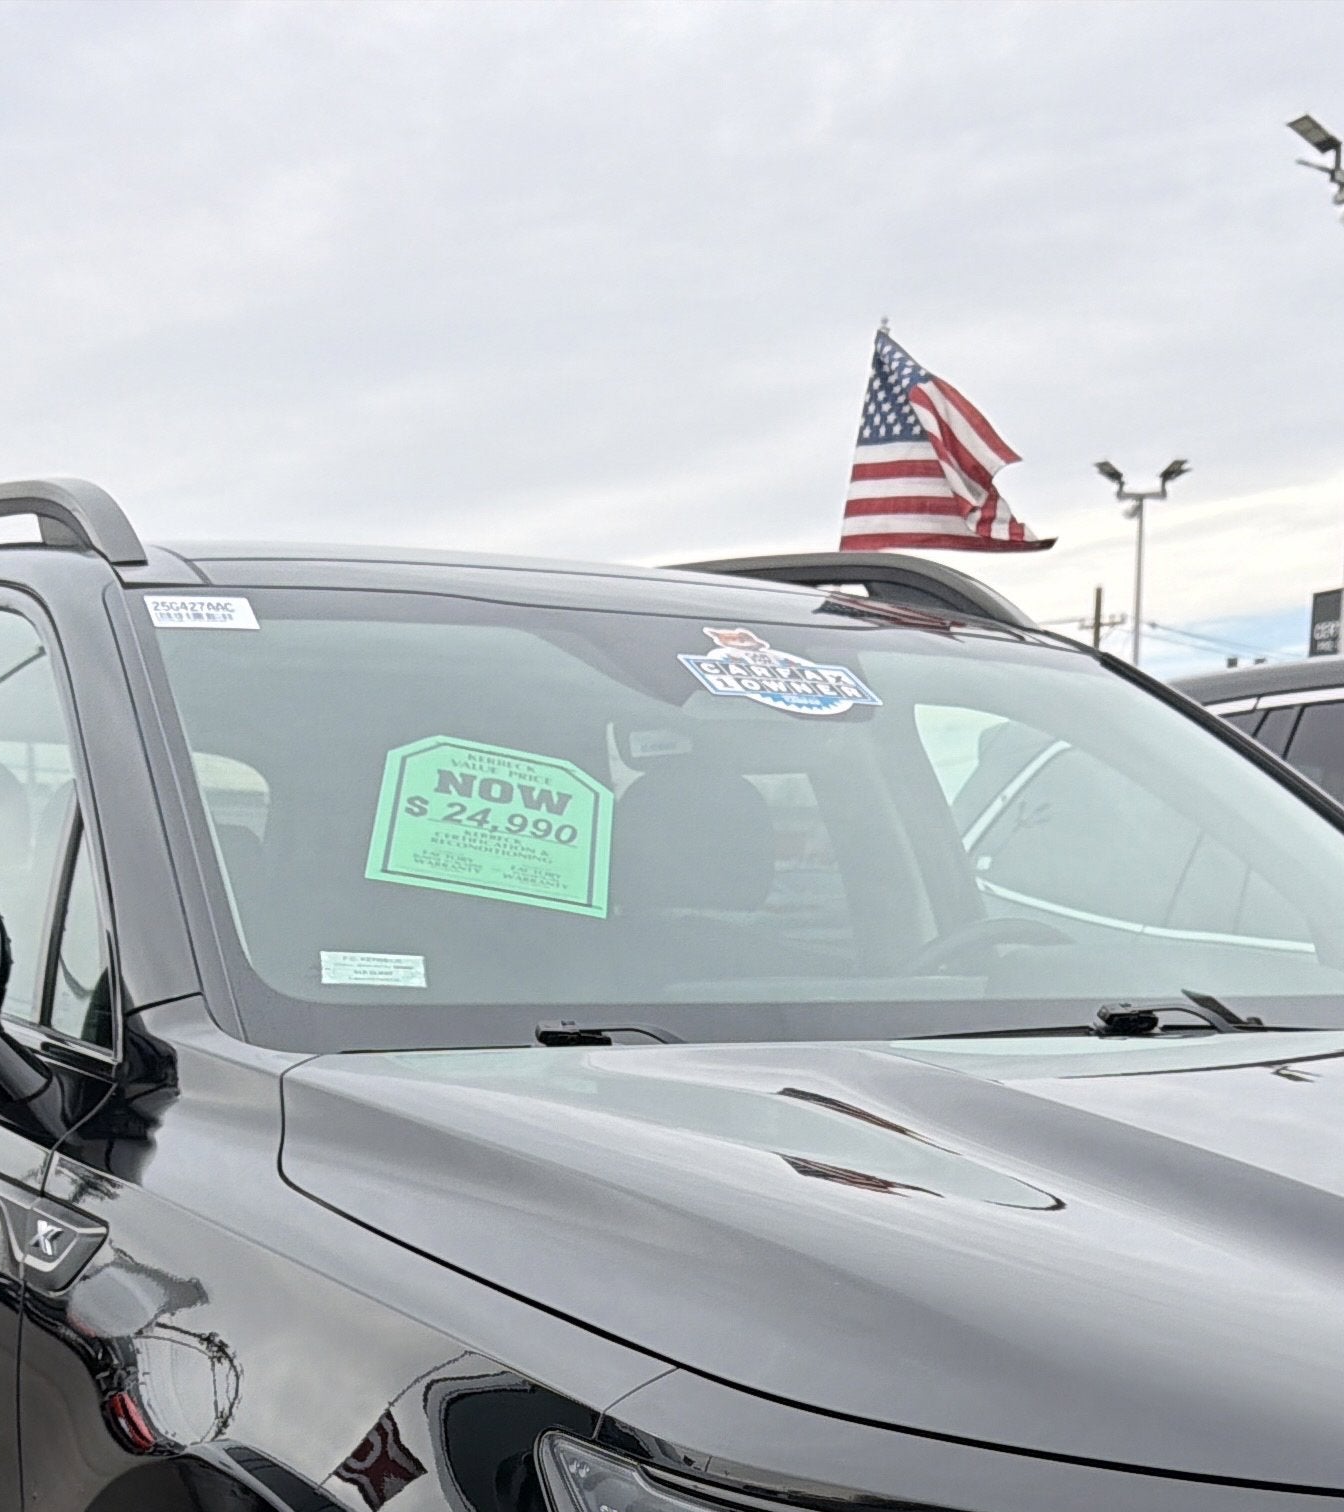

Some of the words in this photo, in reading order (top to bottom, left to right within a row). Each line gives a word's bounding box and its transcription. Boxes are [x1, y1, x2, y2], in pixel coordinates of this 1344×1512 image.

[699, 661, 857, 685] CARFAX
[740, 678, 863, 699] OWNER
[450, 758, 497, 774] VALUE
[508, 769, 553, 785] PRICE
[467, 753, 536, 774] KERBECK
[433, 768, 573, 817] NOW
[404, 795, 430, 818] $
[441, 801, 578, 846] 24,990
